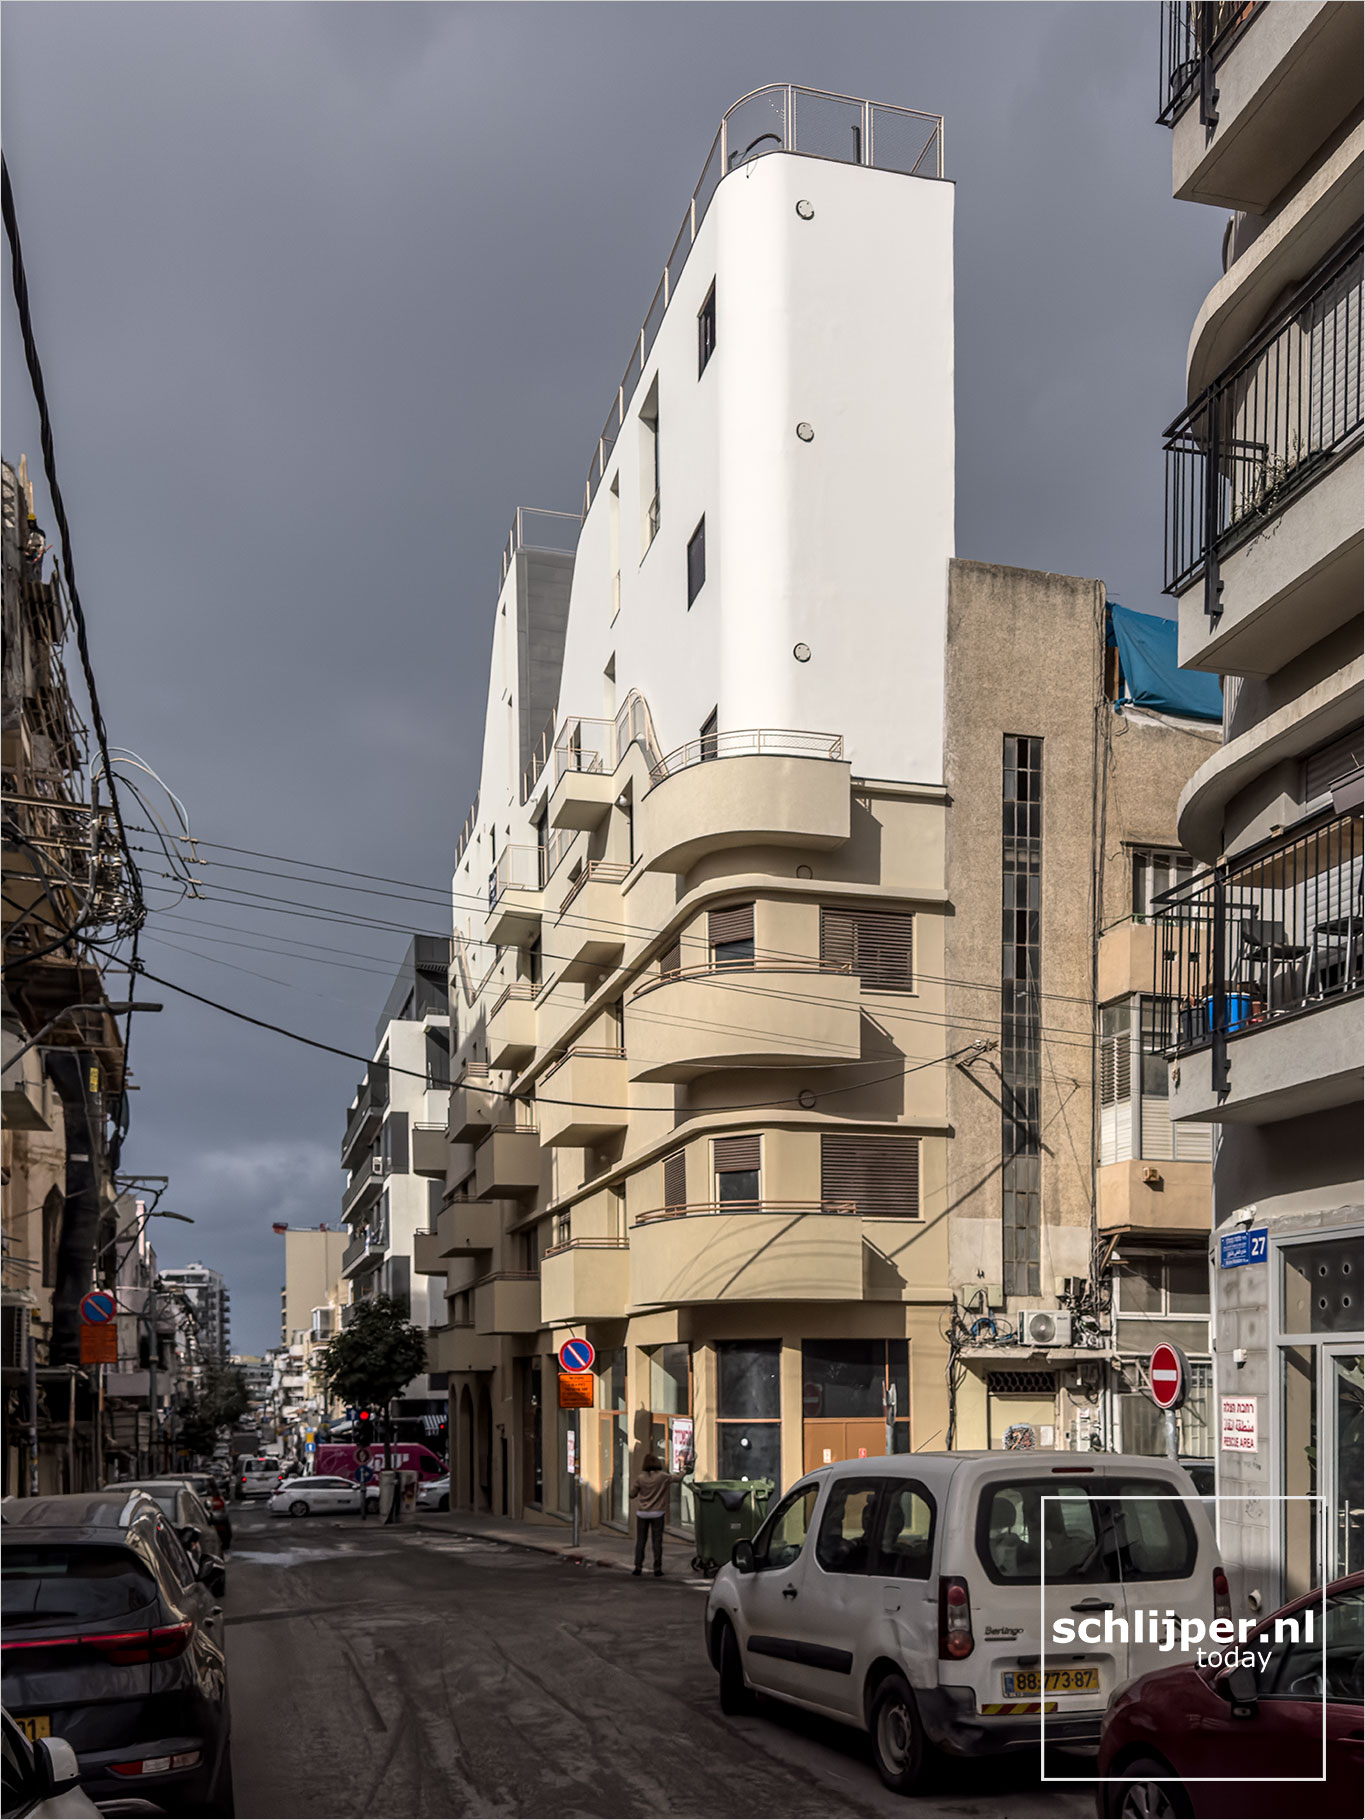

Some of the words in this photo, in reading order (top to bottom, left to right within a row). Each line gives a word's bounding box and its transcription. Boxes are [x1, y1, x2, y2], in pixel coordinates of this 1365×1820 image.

[1251, 1236, 1266, 1256] 27
[1240, 1437, 1255, 1448] AREA
[984, 1626, 1024, 1636] Berlingo
